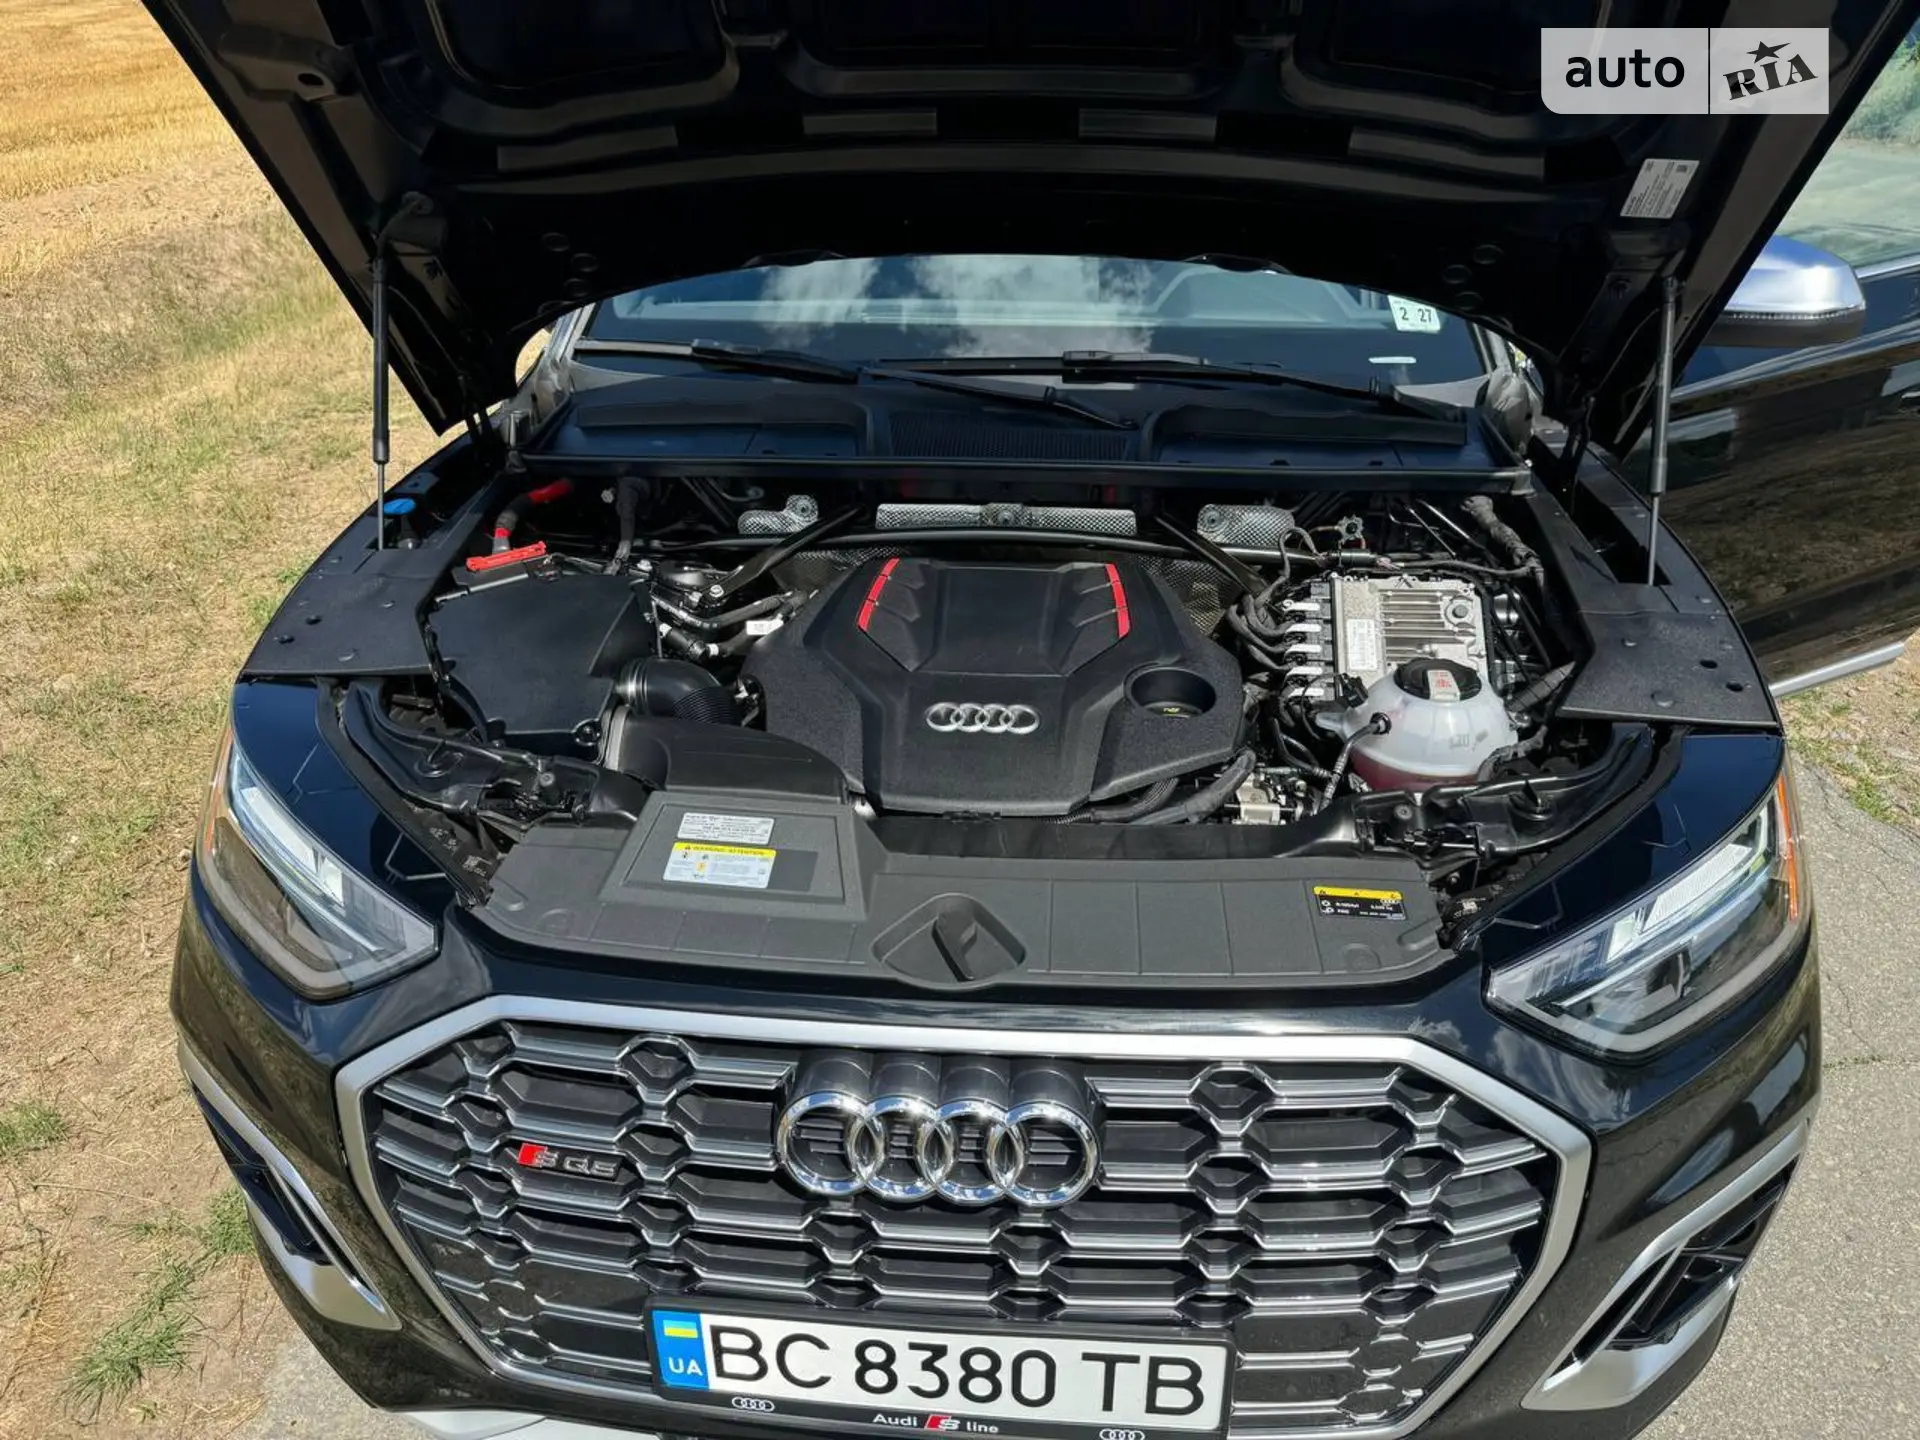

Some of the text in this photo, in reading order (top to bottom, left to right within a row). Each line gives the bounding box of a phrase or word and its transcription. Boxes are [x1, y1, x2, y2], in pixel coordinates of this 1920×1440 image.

[1400, 307, 1432, 323] 2 27
[668, 1357, 703, 1376] UA
[709, 1325, 1205, 1415] BC 8380 TB
[872, 1413, 918, 1427] Audi
[966, 1421, 999, 1433] line
